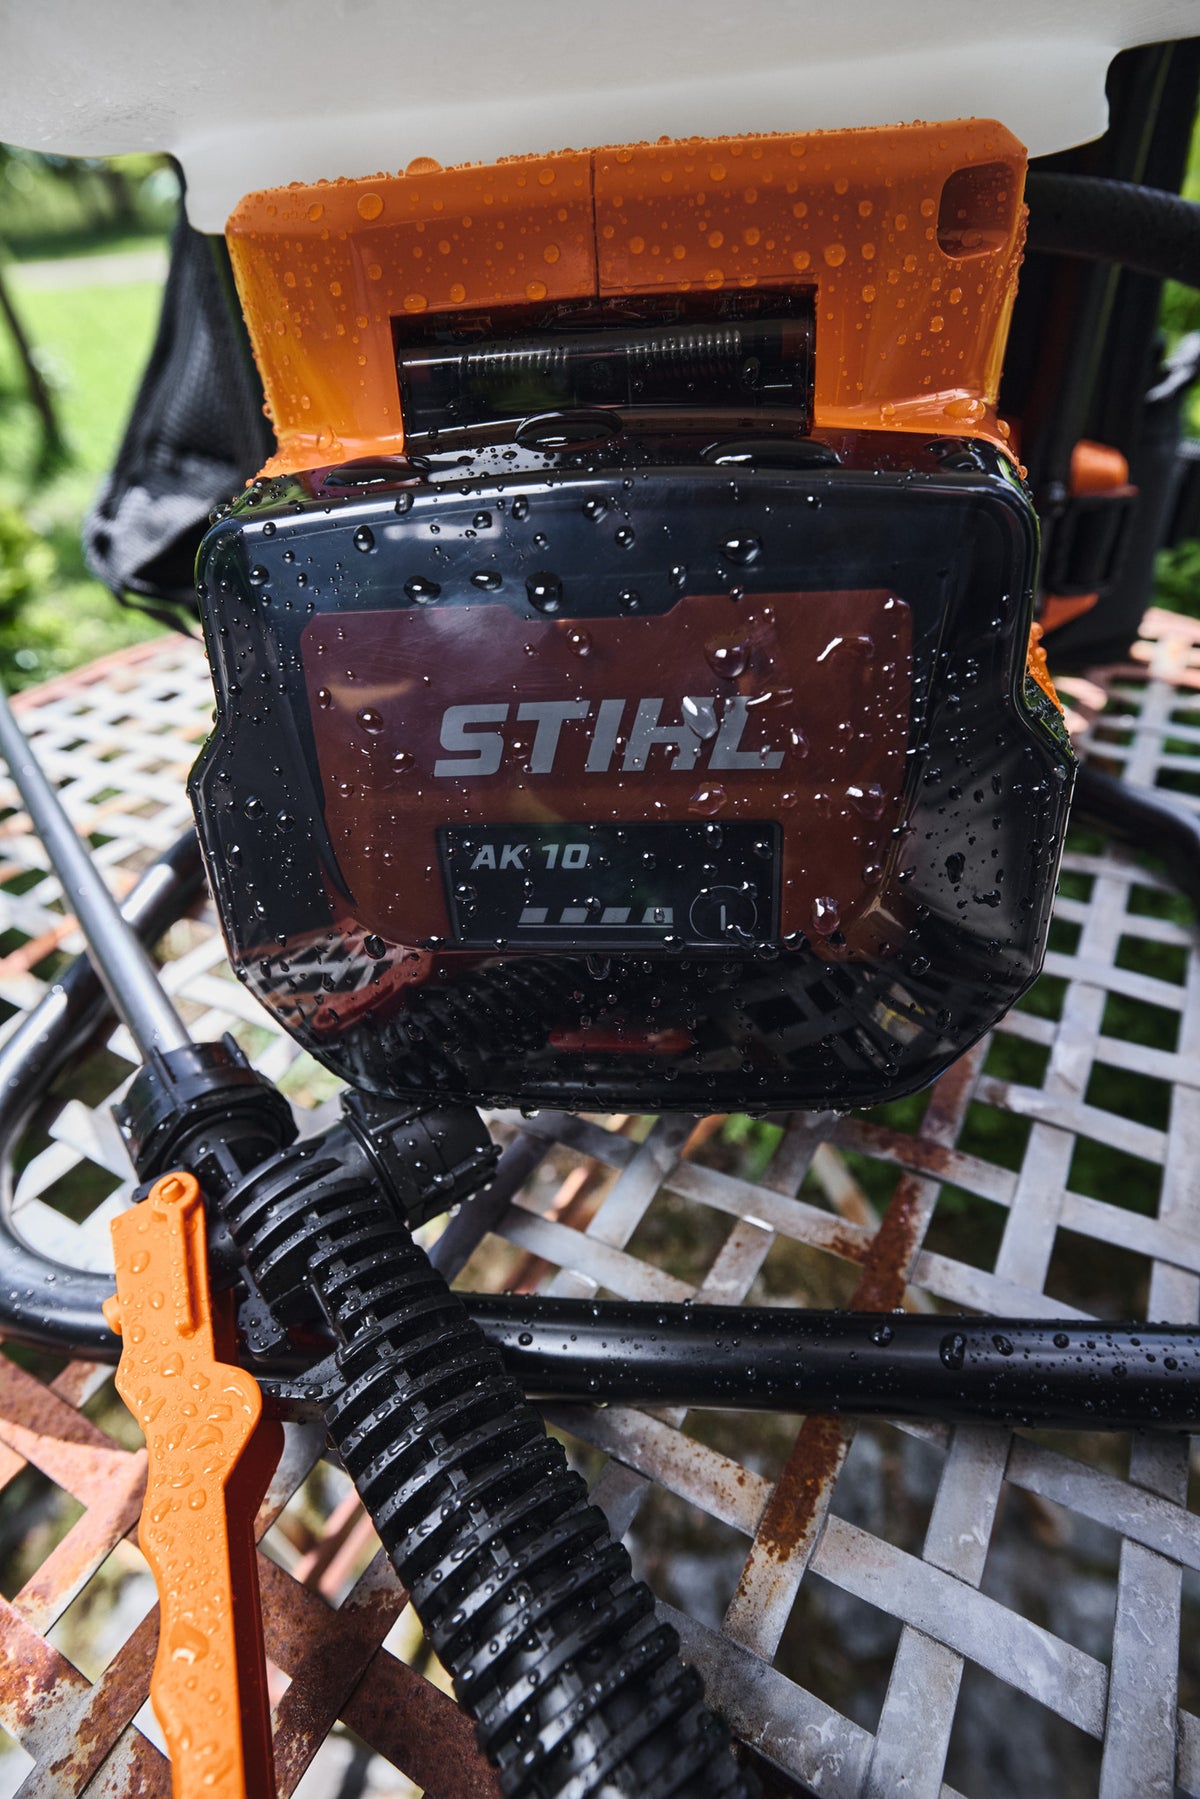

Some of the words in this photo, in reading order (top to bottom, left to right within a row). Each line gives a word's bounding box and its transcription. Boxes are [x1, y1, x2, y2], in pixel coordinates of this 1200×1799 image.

[434, 696, 785, 777] STIHL
[470, 843, 526, 870] AK
[541, 843, 591, 870] 10
